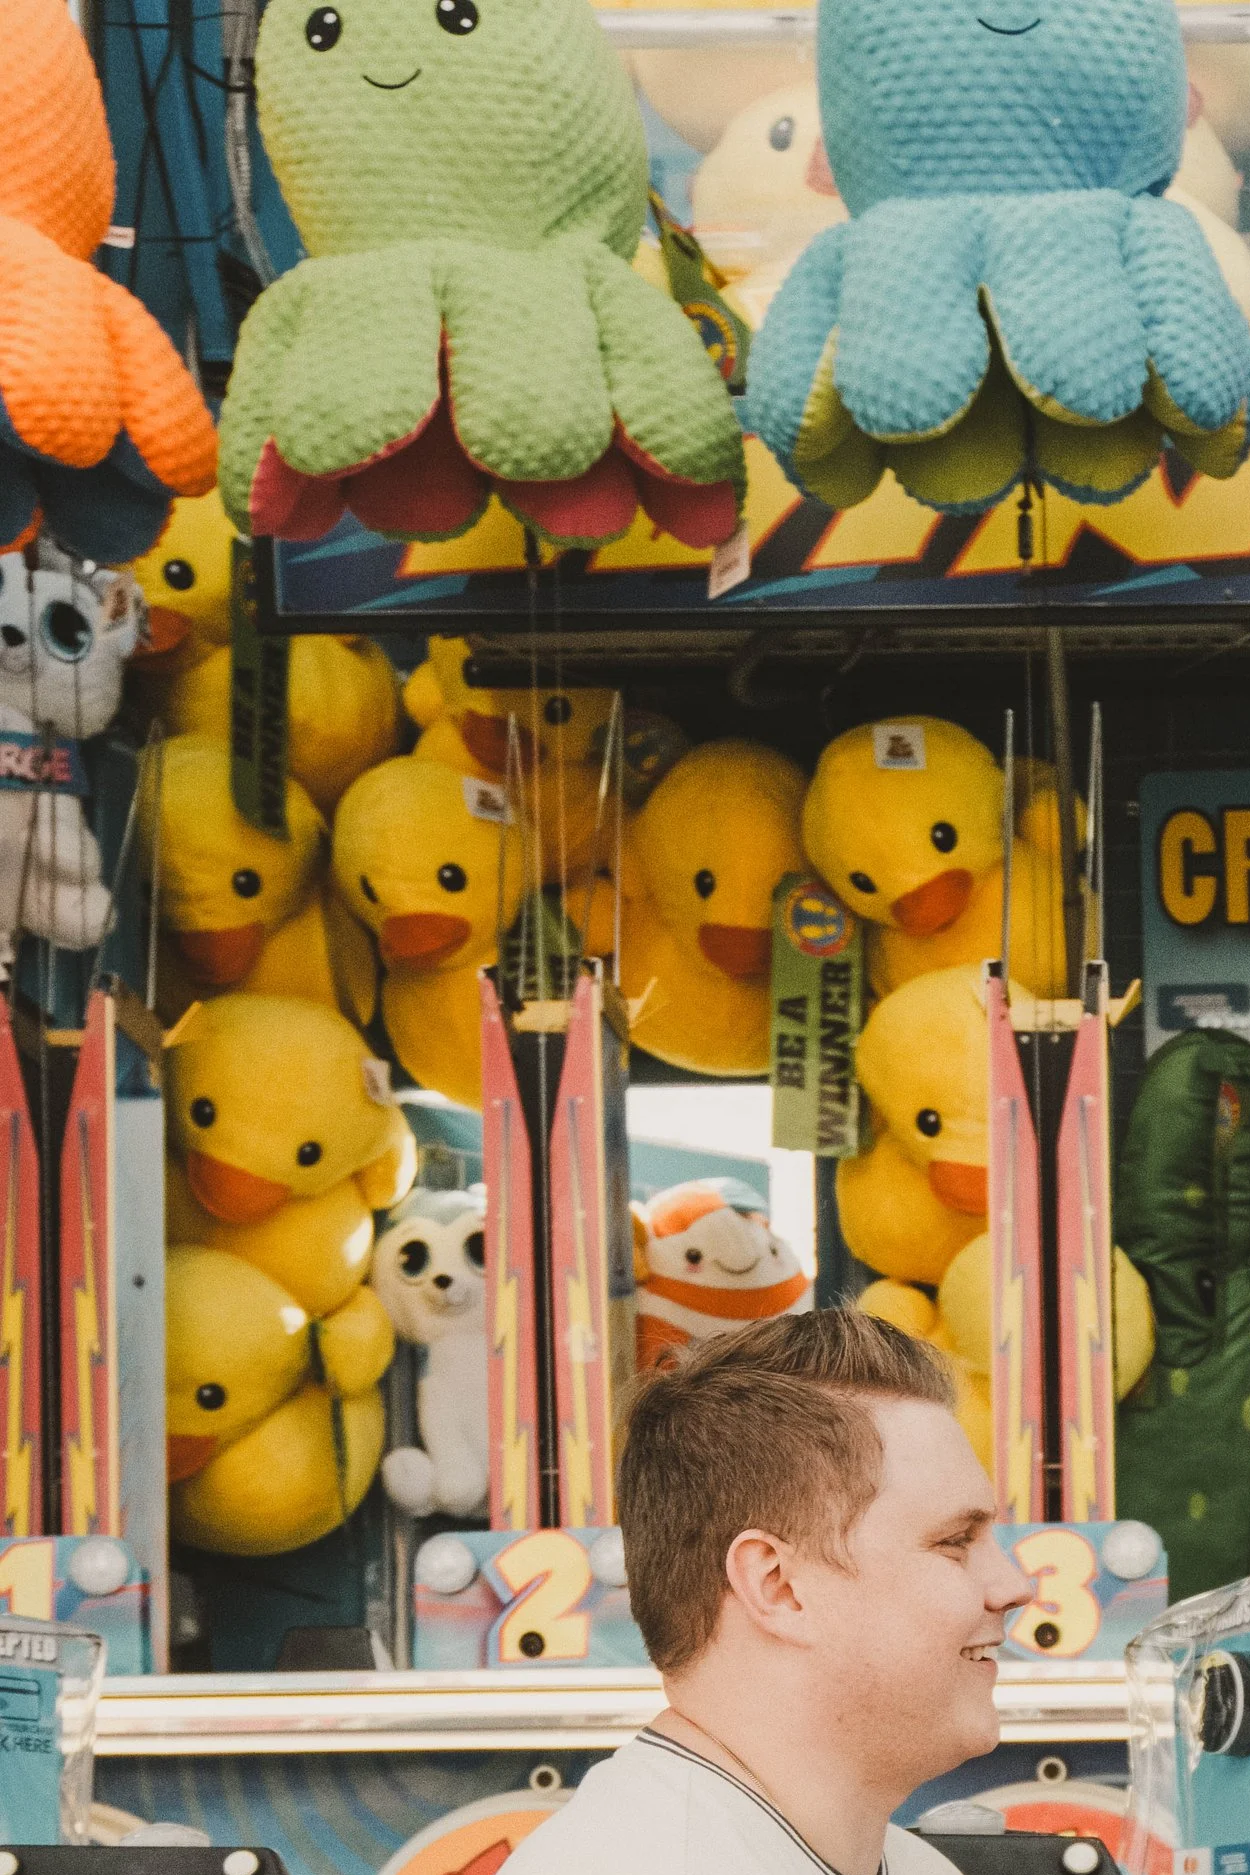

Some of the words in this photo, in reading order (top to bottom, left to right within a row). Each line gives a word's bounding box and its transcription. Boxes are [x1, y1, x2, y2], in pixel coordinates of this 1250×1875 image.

[777, 1032, 807, 1089] BE
[778, 996, 808, 1024] A
[819, 961, 852, 1148] WINNER
[493, 1528, 594, 1663] 2
[1008, 1527, 1103, 1658] 3
